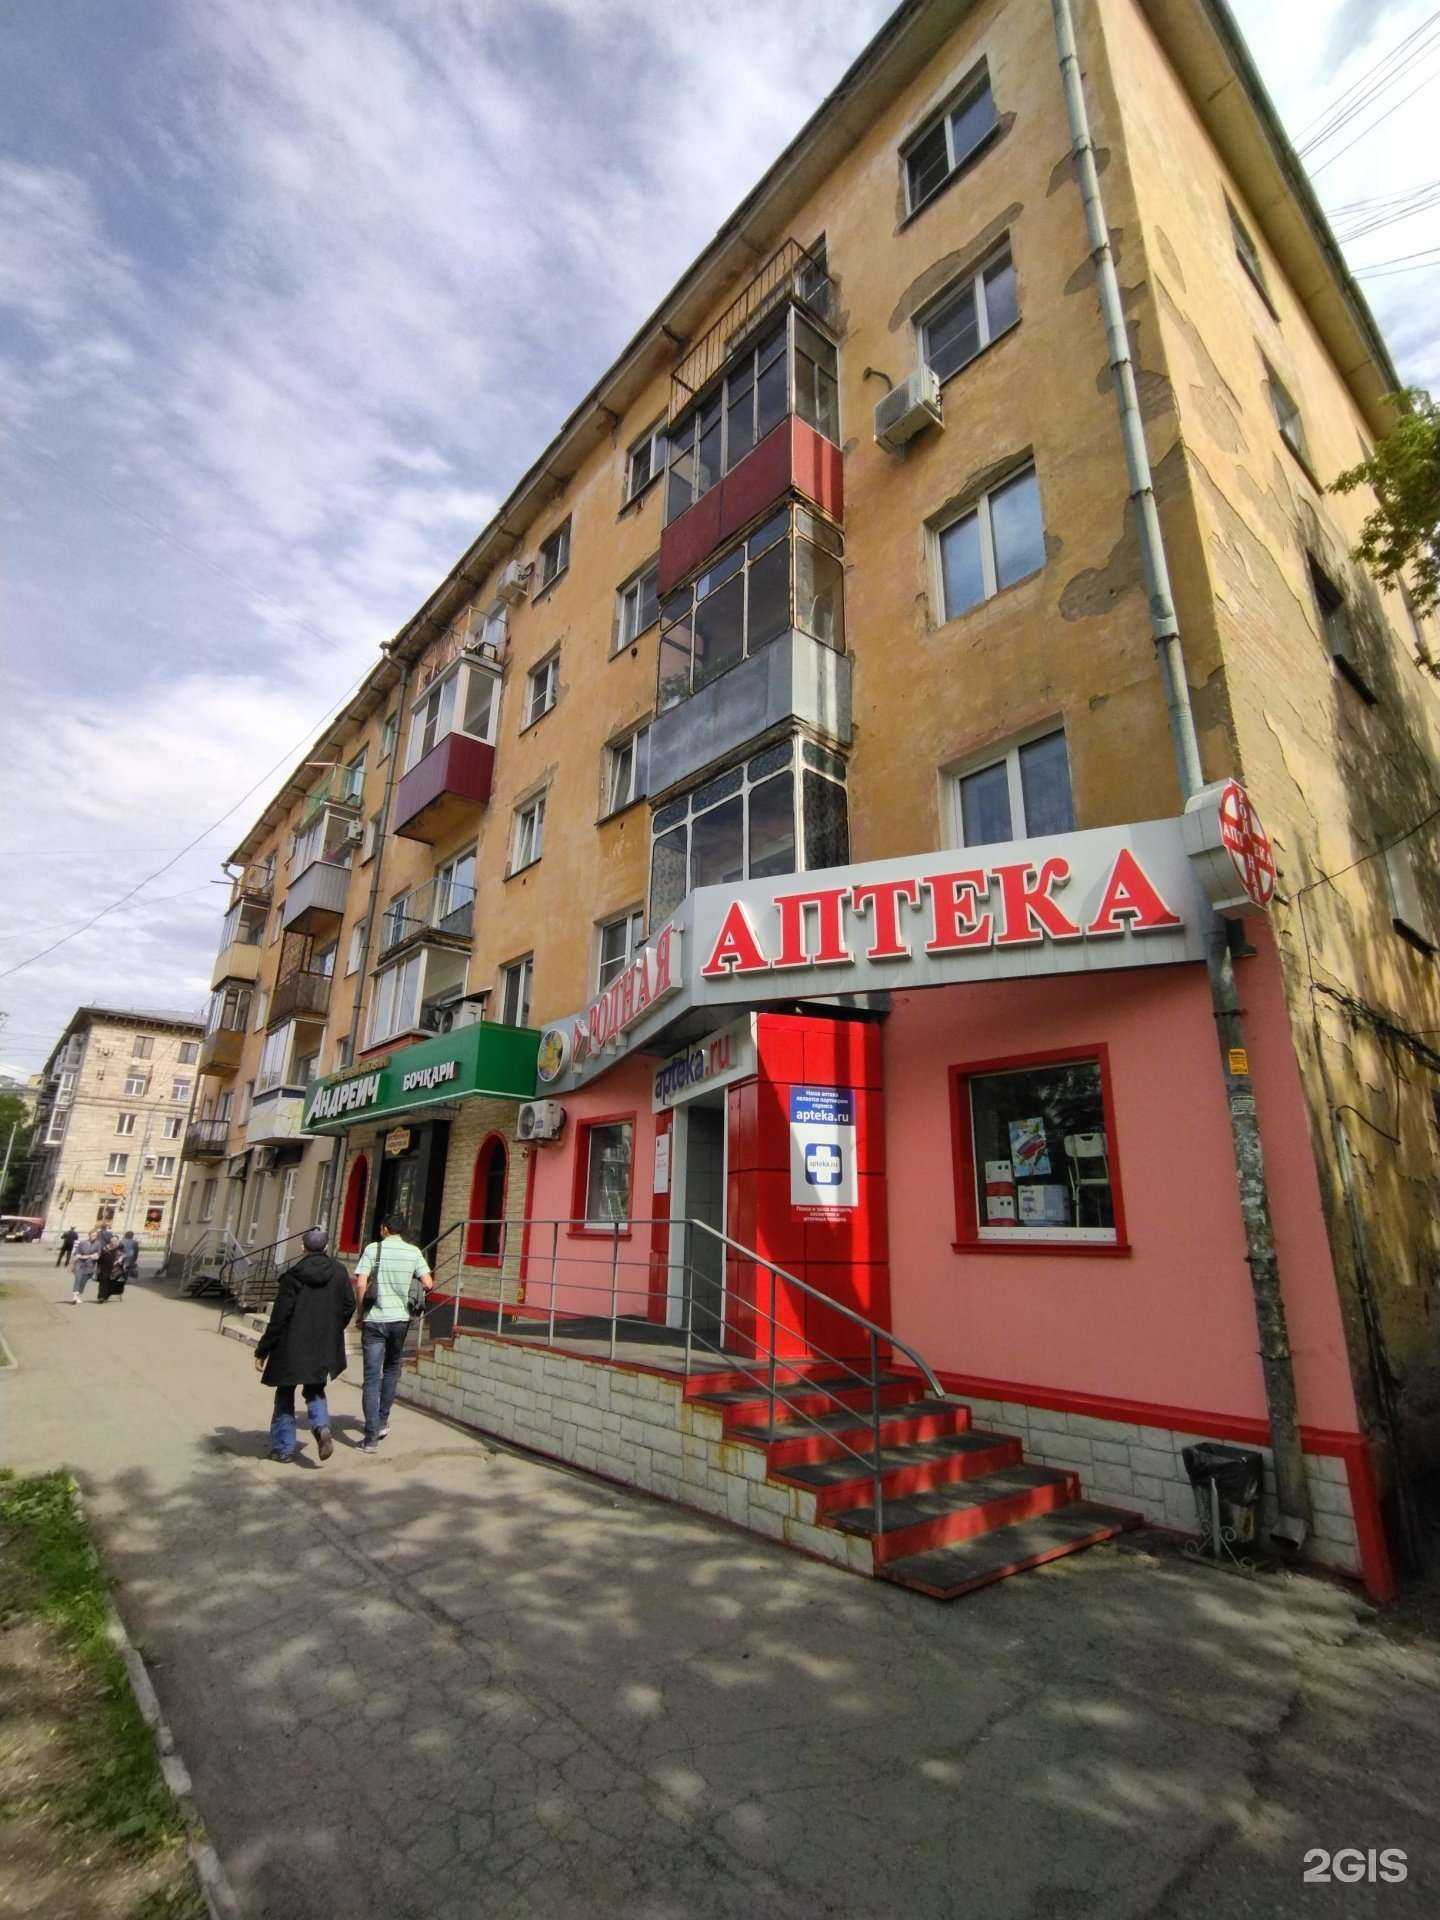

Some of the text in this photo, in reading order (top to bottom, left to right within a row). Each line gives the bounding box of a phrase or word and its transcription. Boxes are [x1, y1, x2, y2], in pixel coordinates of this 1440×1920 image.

[587, 847, 1183, 1057] РОДНАЯ АПТЕКА
[402, 1060, 456, 1091] БОЧКАРИ
[655, 1035, 730, 1105] apteka.ru
[796, 1110, 849, 1123] apteka.ru
